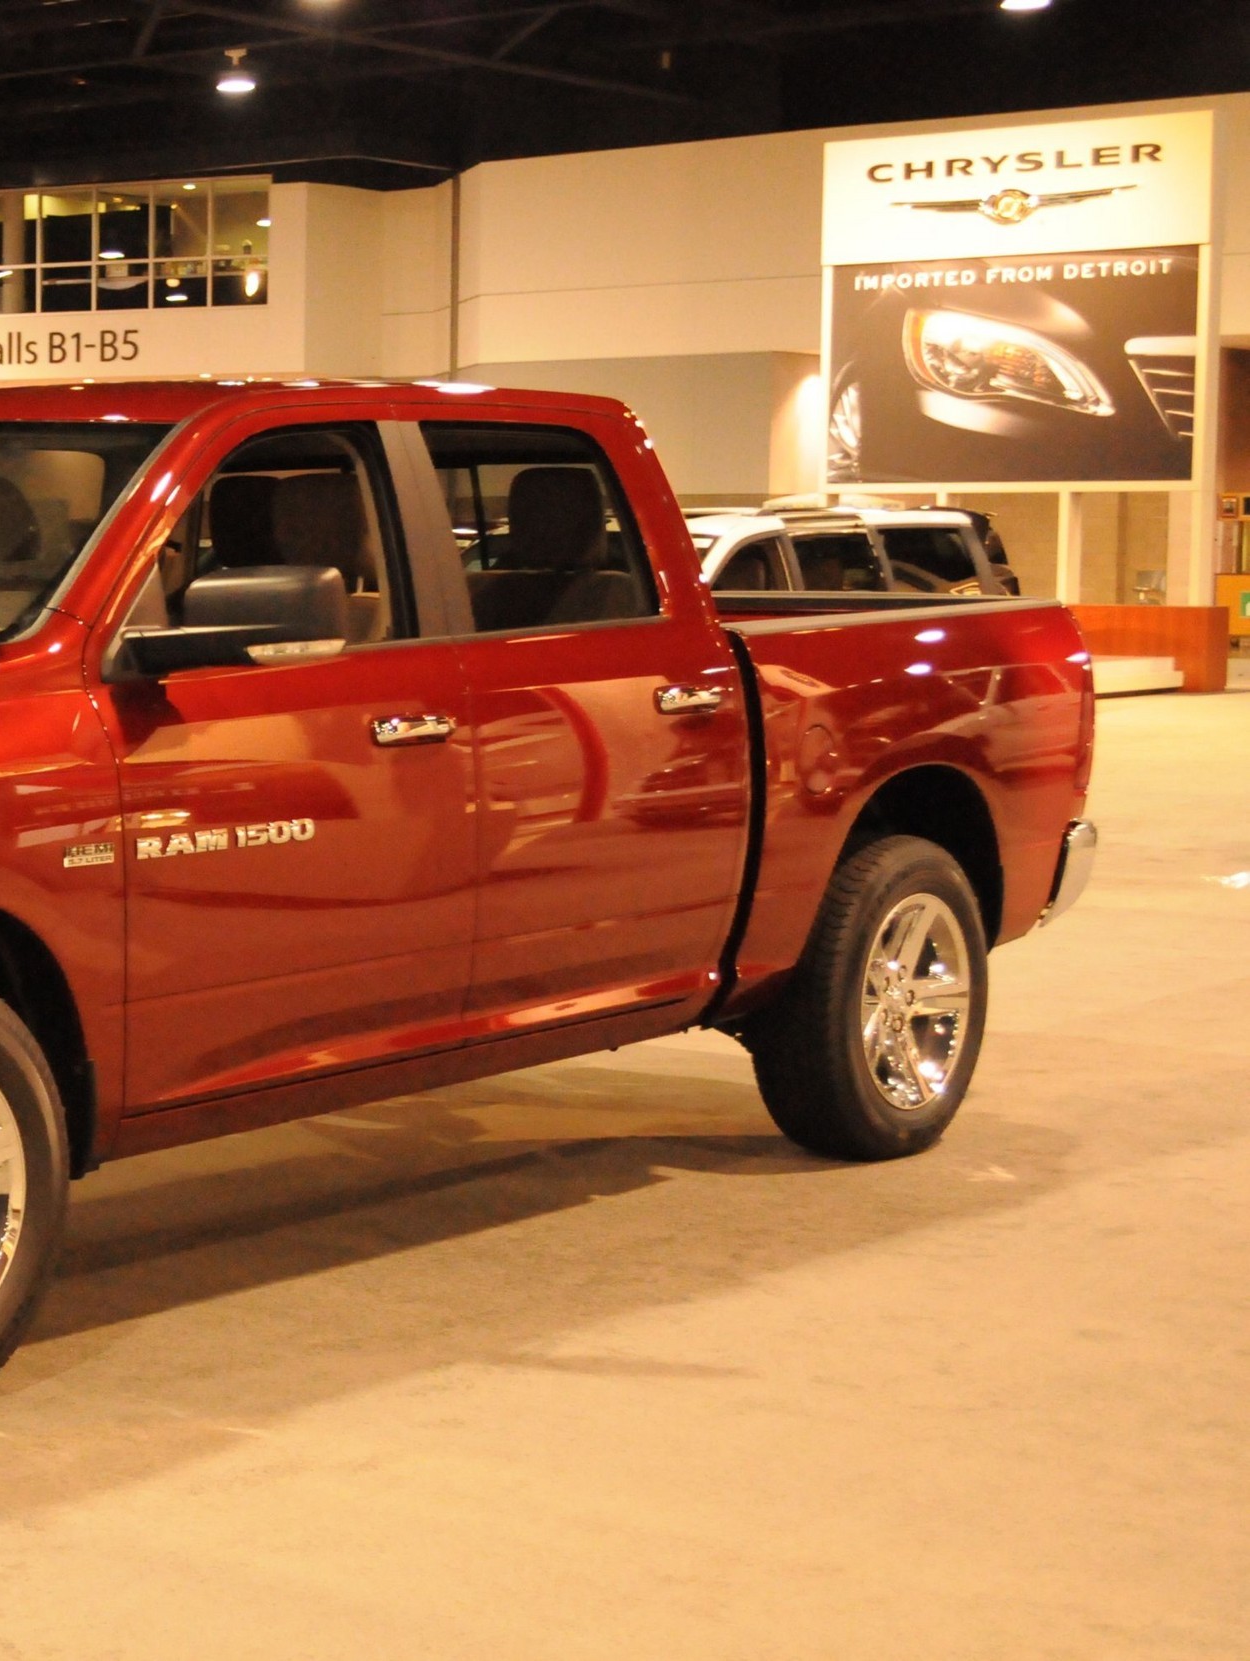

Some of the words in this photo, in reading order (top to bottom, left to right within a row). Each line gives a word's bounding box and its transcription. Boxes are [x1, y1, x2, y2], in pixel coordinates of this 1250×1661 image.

[867, 143, 1162, 183] CHRYSLER
[854, 270, 976, 291] IMPORTED
[986, 265, 1052, 284] FROM
[1063, 258, 1173, 279] DETROIT
[49, 329, 140, 364] B1-B5
[63, 842, 115, 858] HEMI
[136, 828, 229, 860] RAM
[235, 818, 316, 848] 1500
